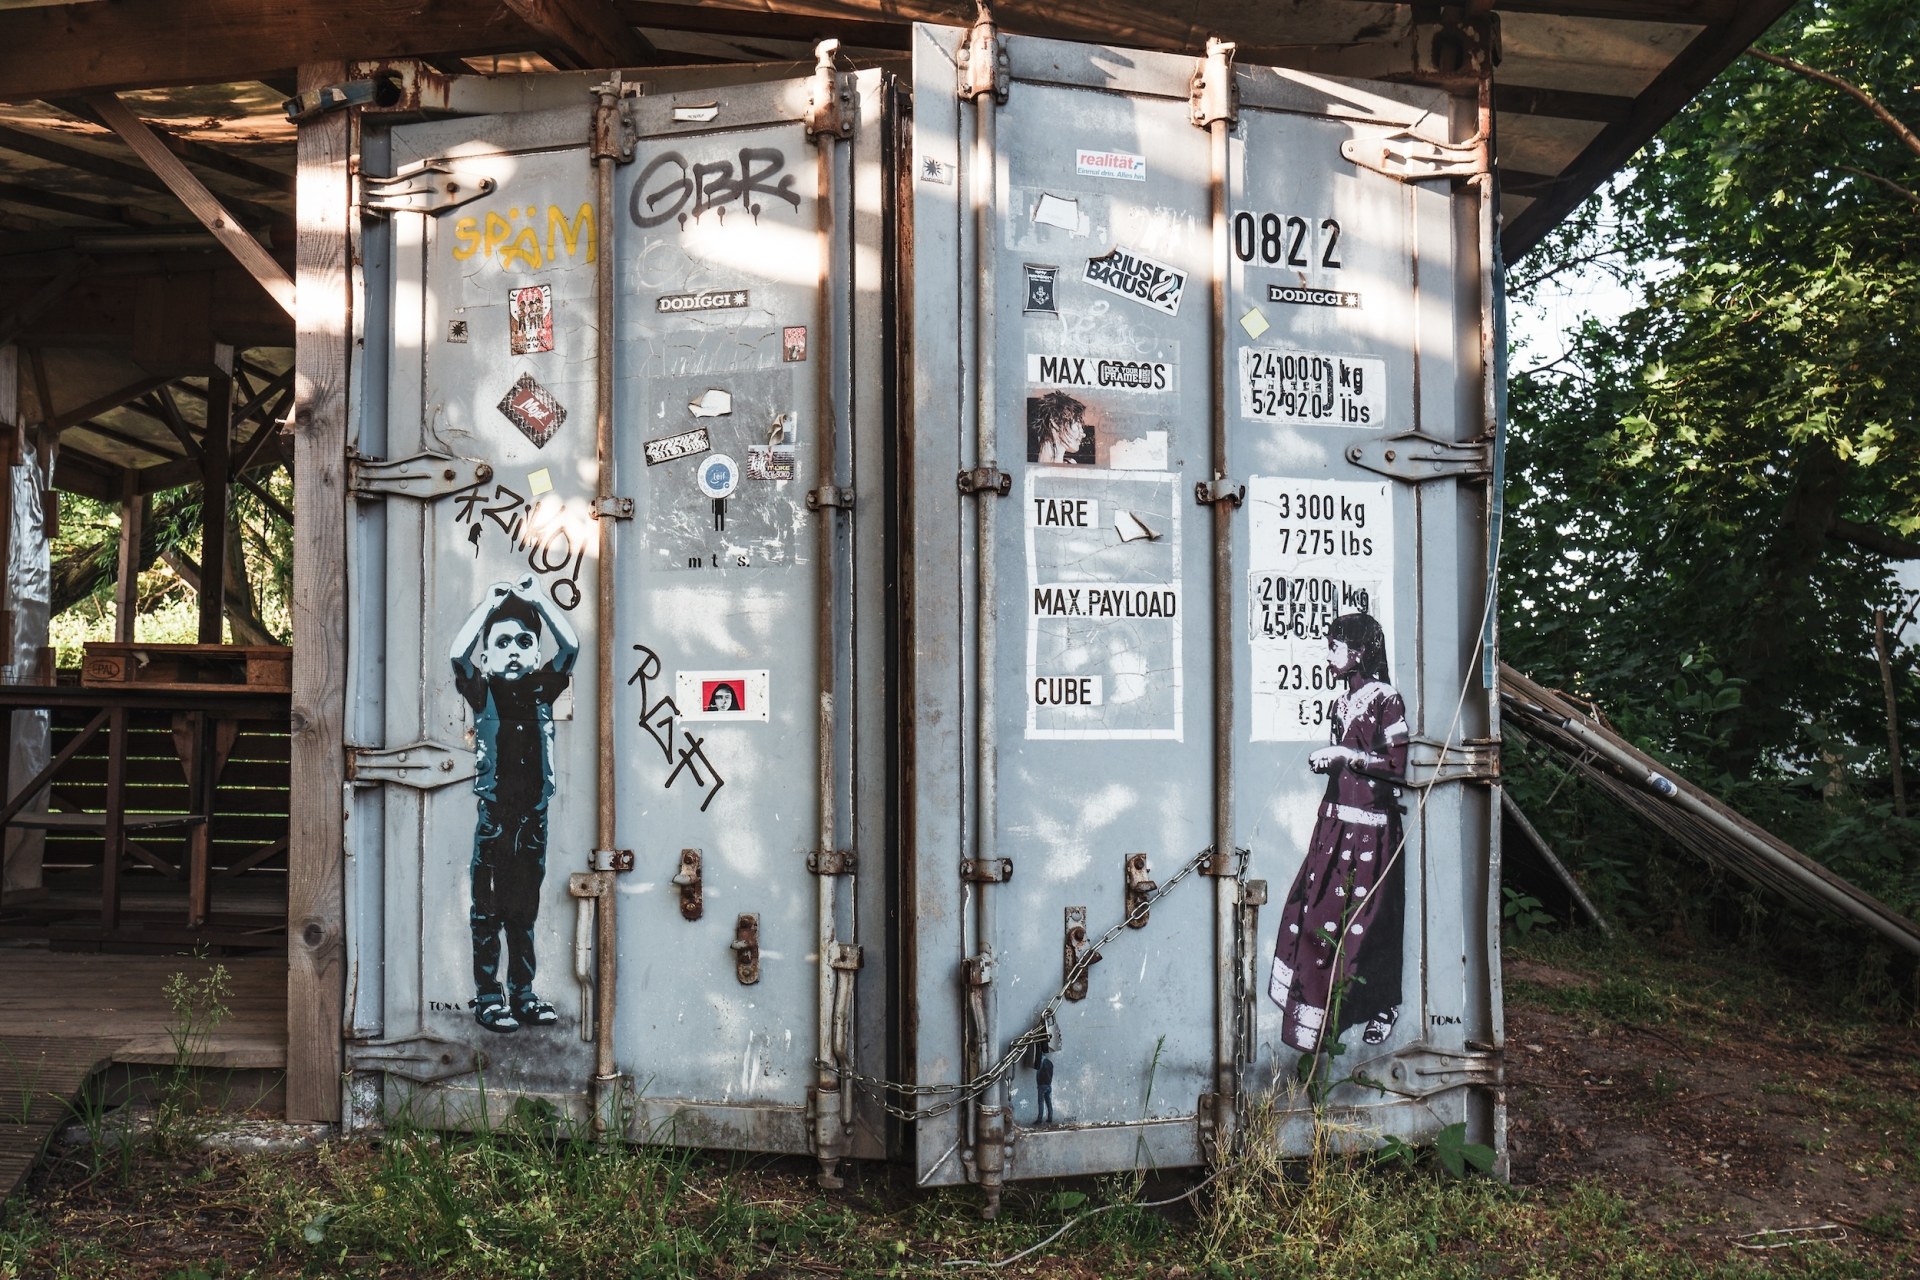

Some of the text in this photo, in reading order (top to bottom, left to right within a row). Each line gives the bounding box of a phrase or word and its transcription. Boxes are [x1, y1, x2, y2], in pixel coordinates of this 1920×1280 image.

[1080, 154, 1134, 169] realität
[453, 202, 598, 269] SPÄM
[659, 295, 731, 311] DODIGGI
[1271, 287, 1342, 306] DODIGGI
[1040, 356, 1092, 386] MAX.
[1034, 499, 1088, 527] TARE
[1341, 496, 1365, 529] kg
[1341, 531, 1373, 556] lbs
[92, 664, 117, 675] EPAL
[1035, 677, 1092, 705] CUBE
[429, 1001, 460, 1011] TONA
[1429, 1014, 1461, 1026] TONA
